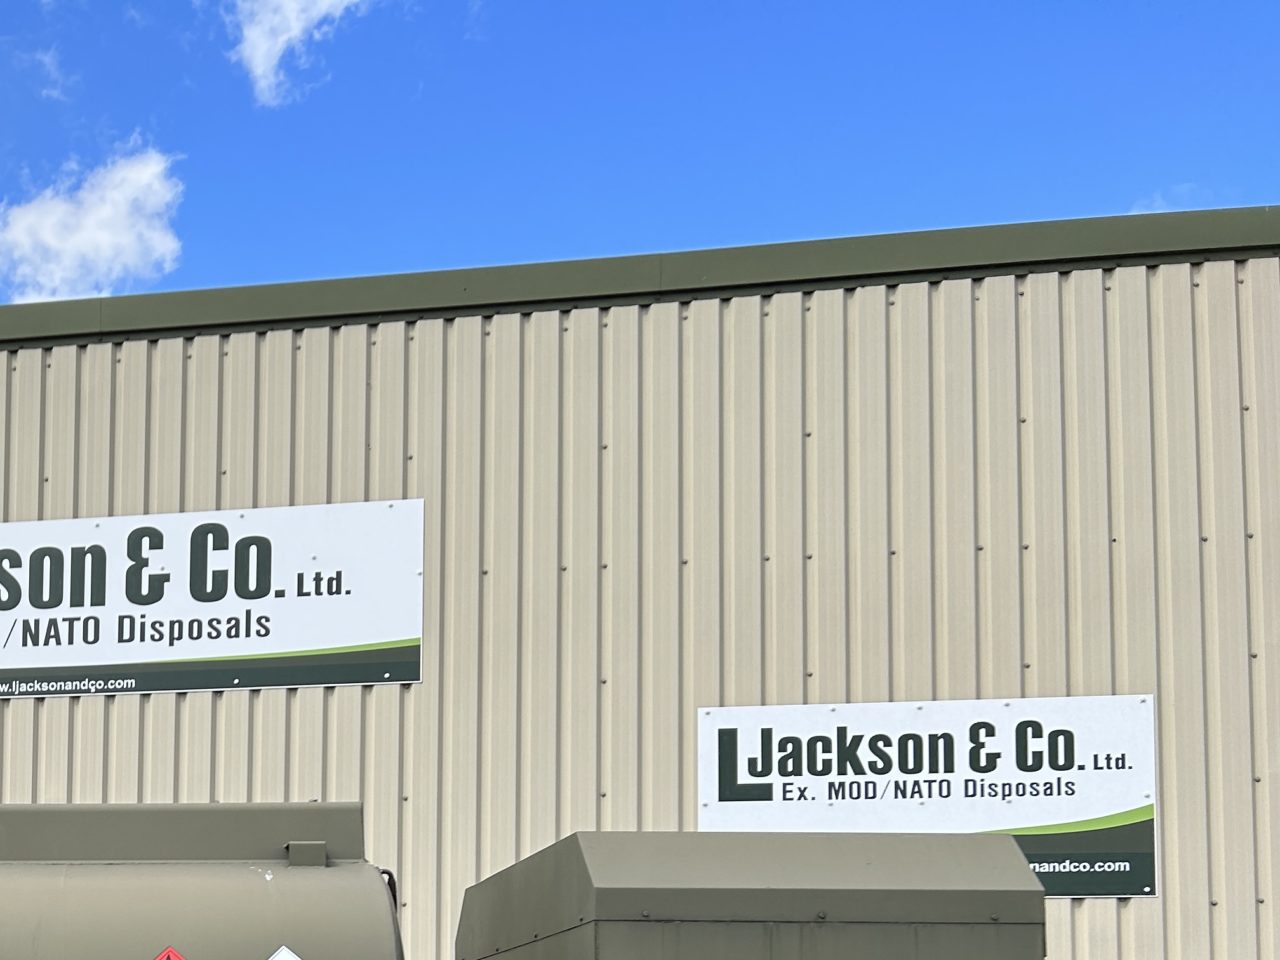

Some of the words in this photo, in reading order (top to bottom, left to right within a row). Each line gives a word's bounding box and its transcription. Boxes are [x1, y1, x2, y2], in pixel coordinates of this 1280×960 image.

[125, 526, 171, 606] &
[189, 522, 286, 603] Co.
[296, 570, 352, 598] Ltd.
[117, 611, 271, 647] Disposals
[968, 721, 1002, 774] &
[1015, 719, 1086, 774] Co.
[1092, 753, 1134, 772] Ltd.
[782, 782, 817, 802] Ex.
[827, 779, 952, 801] MOD/NATO
[964, 777, 1076, 801] Disposals
